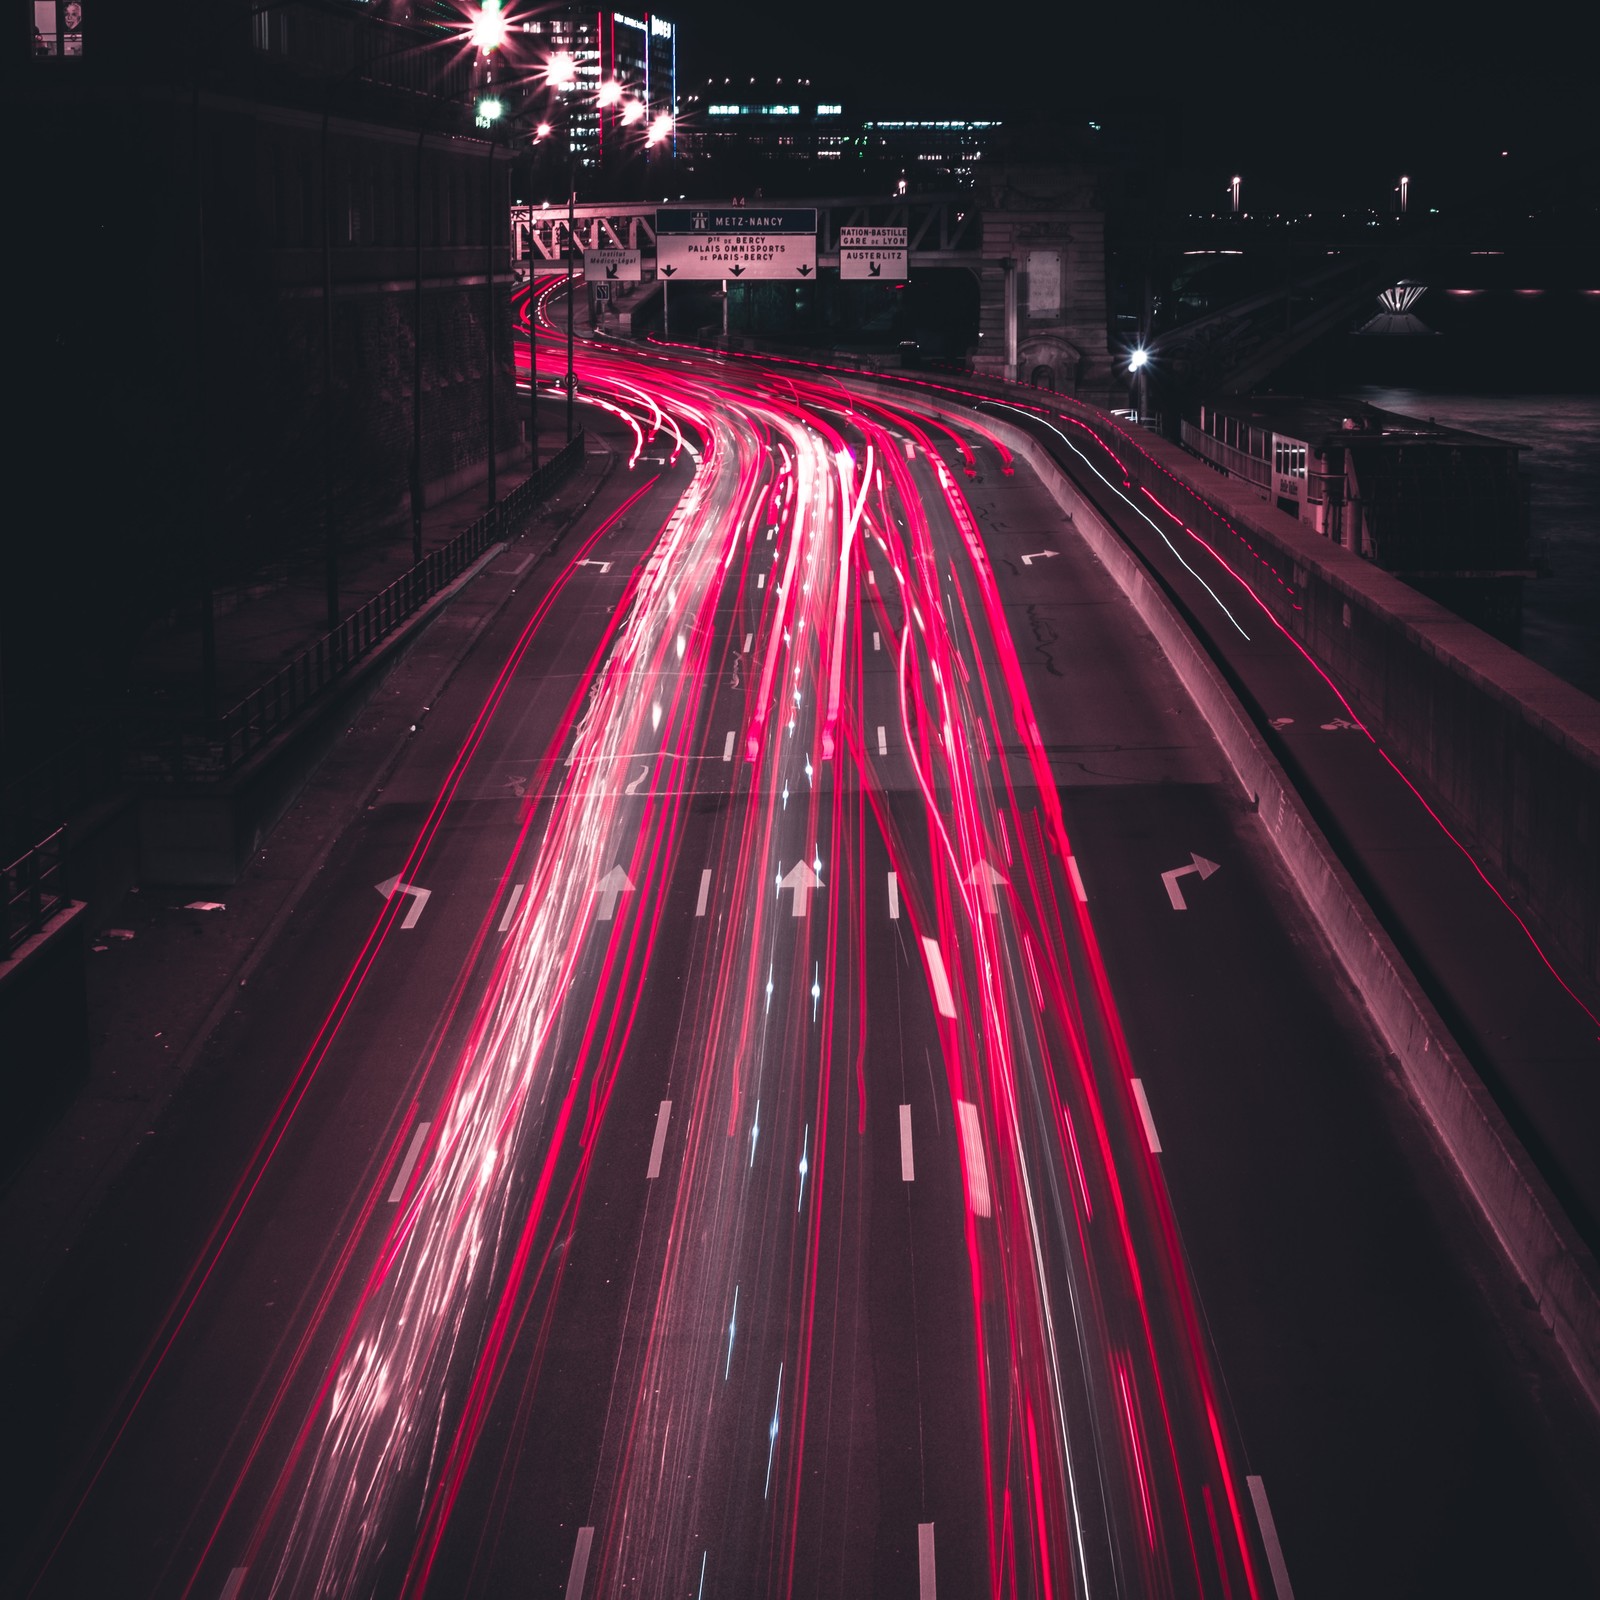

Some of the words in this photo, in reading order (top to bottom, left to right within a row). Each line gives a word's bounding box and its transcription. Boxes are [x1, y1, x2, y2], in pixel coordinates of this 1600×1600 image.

[715, 217, 784, 226] METZ-NANCY
[843, 237, 867, 245] GARE
[883, 237, 905, 245] LYON
[688, 245, 721, 253] PALAIS
[724, 245, 786, 253] OMNISPORTS
[712, 253, 774, 261] PARIS-BERCY
[846, 252, 902, 260] AUSTERLITZ
[590, 257, 637, 265] Médico-Légal
